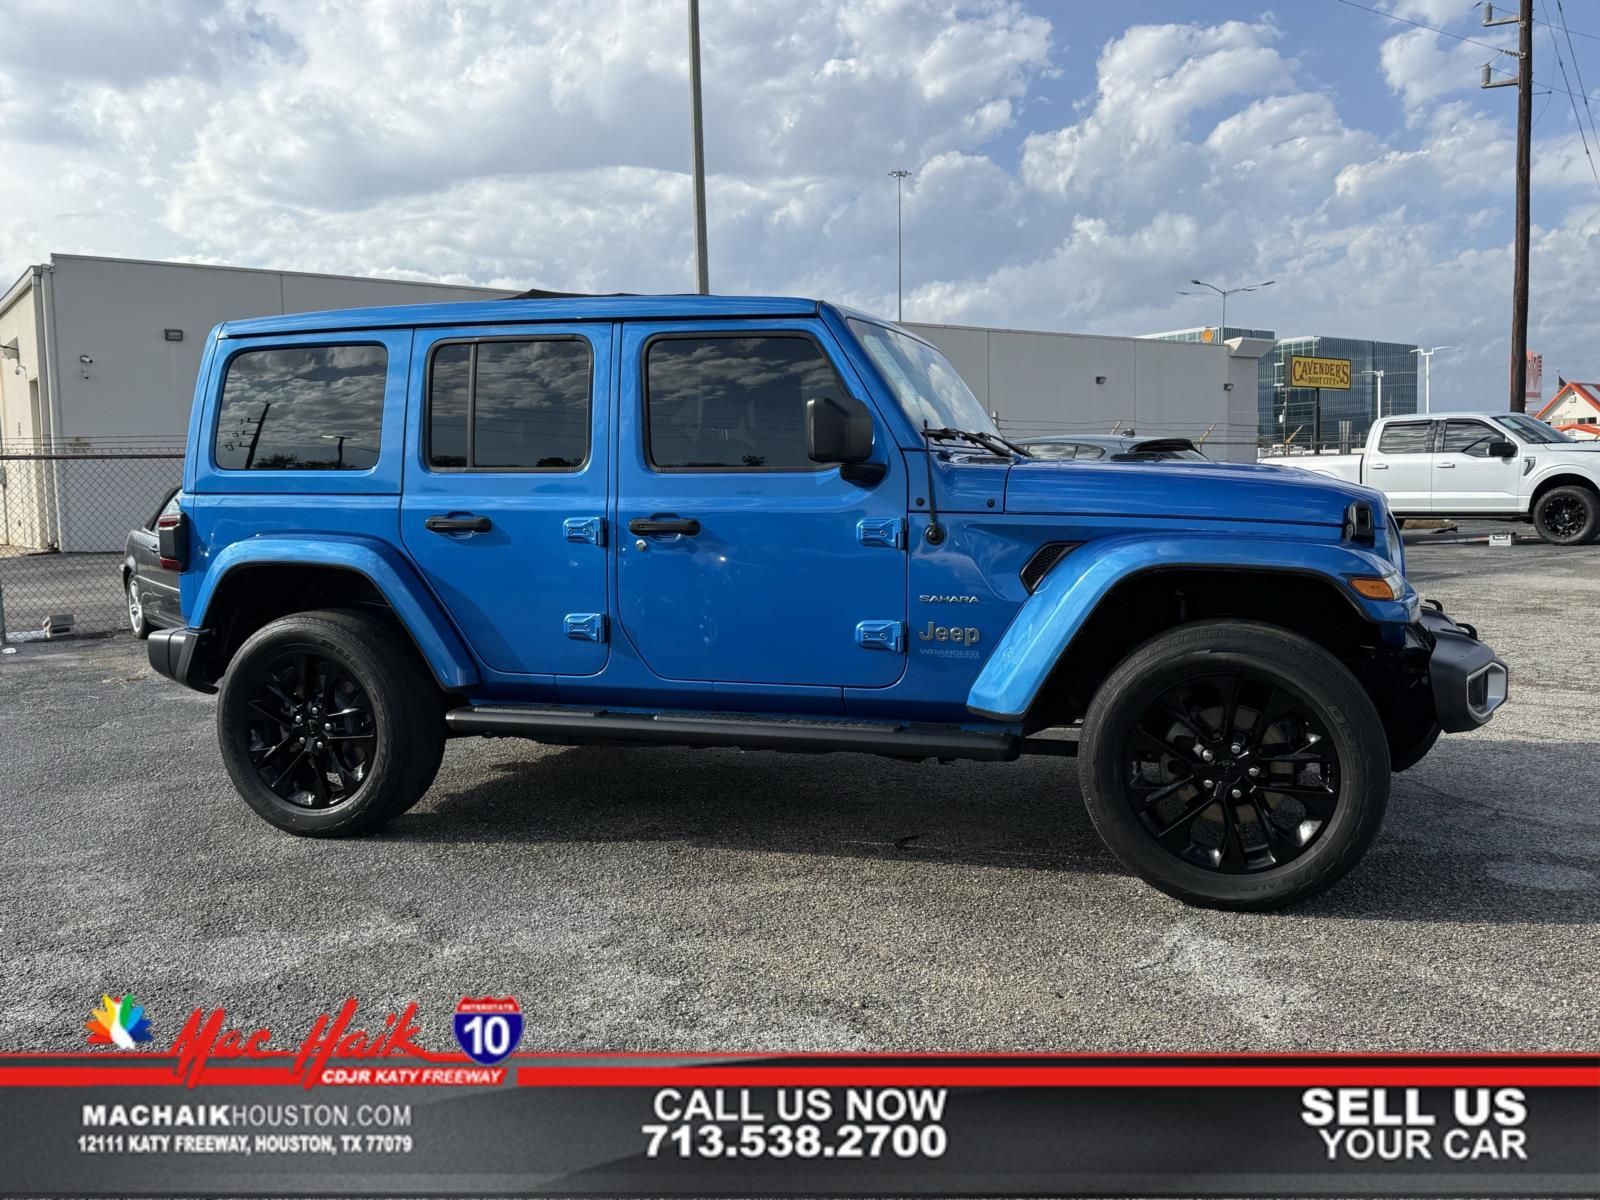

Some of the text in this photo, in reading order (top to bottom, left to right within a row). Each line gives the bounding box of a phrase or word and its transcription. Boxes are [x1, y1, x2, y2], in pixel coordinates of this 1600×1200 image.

[1293, 360, 1349, 384] CAVENDER'S
[1308, 376, 1338, 385] BOOT CITY
[919, 595, 979, 603] SAHARA
[919, 621, 980, 647] Jeep
